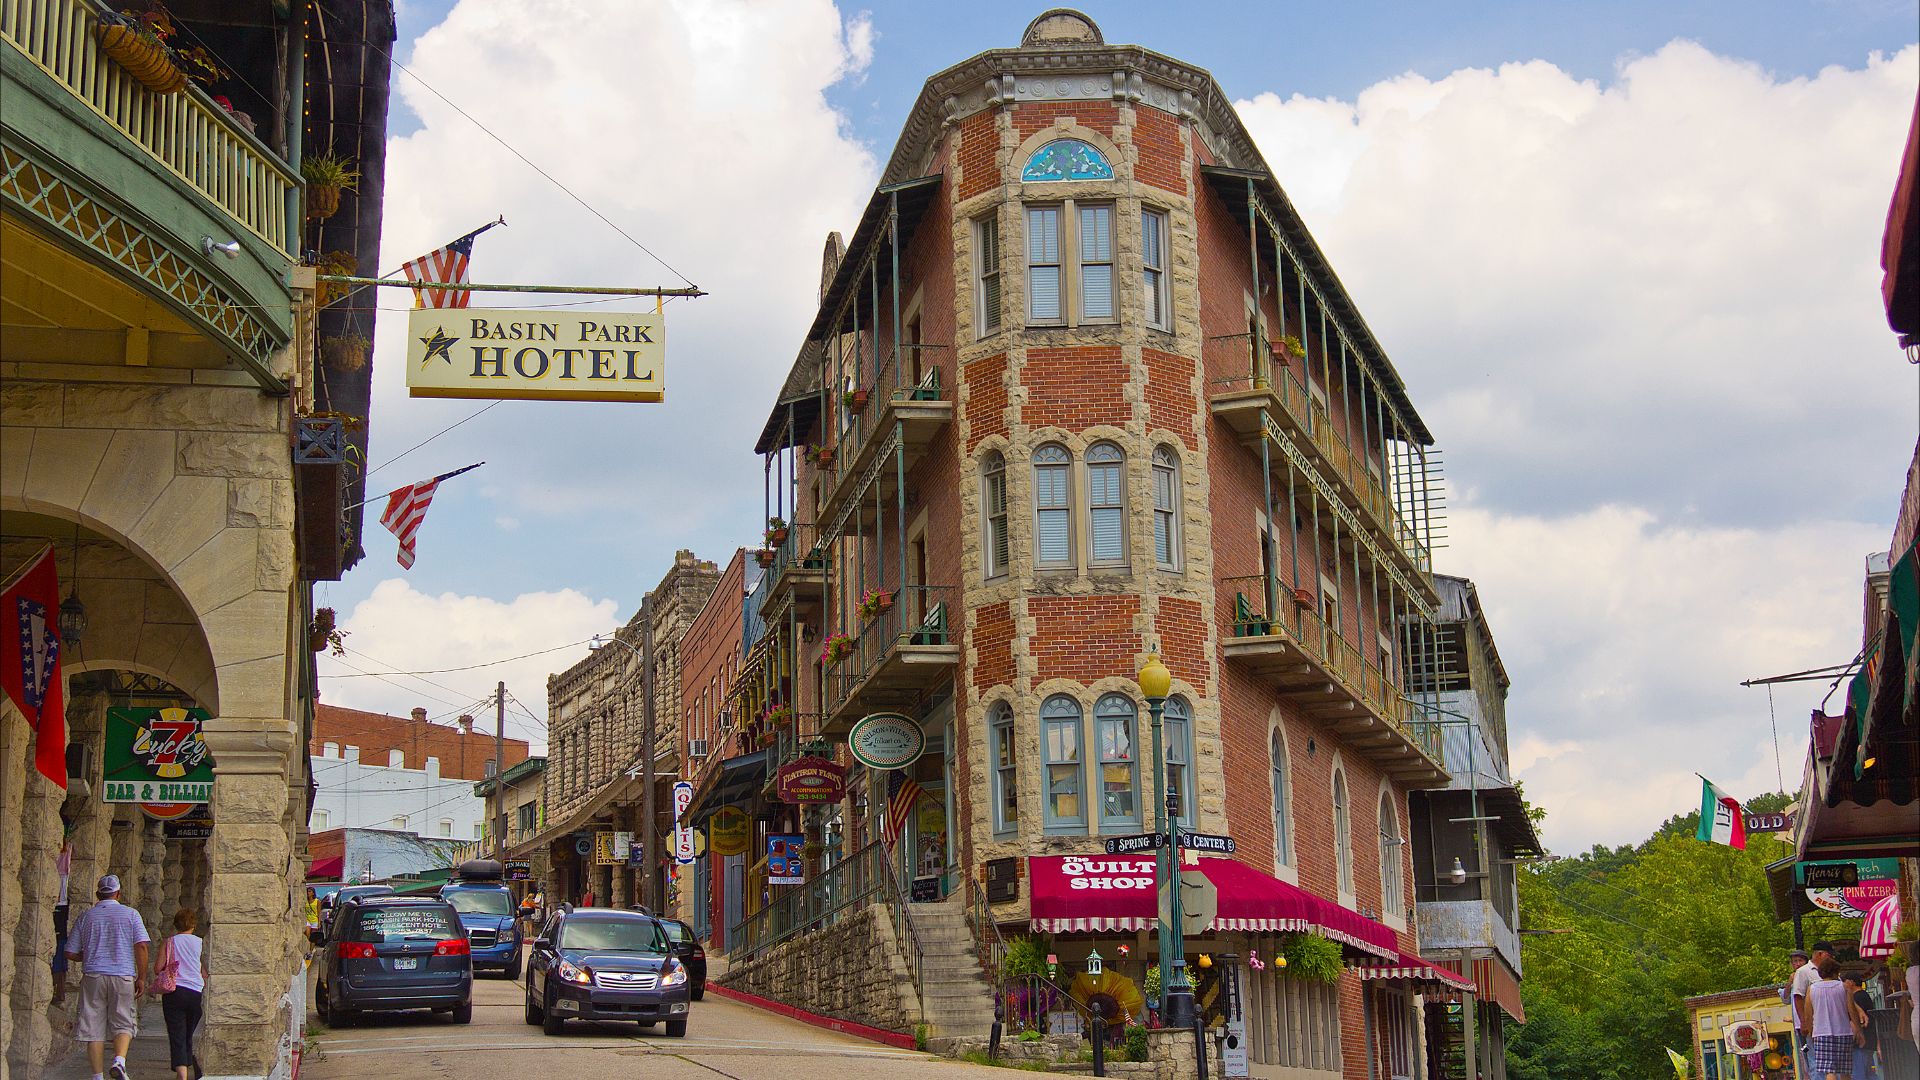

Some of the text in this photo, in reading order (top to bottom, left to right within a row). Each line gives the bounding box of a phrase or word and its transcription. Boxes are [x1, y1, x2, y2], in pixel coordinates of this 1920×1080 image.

[470, 318, 654, 344] BASIN PARK
[469, 346, 655, 382] HOTEL
[148, 719, 198, 765] 7
[862, 727, 886, 743] WILSON
[889, 725, 912, 743] WILSON
[133, 730, 207, 766] Lucky
[782, 769, 841, 790] FLATIRON FLATS
[106, 784, 136, 800] BAR
[141, 784, 154, 800] &
[677, 794, 691, 852] QULTS
[1749, 816, 1784, 829] OLD
[1119, 836, 1150, 851] SPRING
[1193, 836, 1225, 850] CENTER
[1062, 862, 1156, 875] QUILT
[1807, 865, 1841, 886] Henri's
[1070, 878, 1154, 889] SHOP
[1846, 885, 1897, 897] PINK ZEBRA
